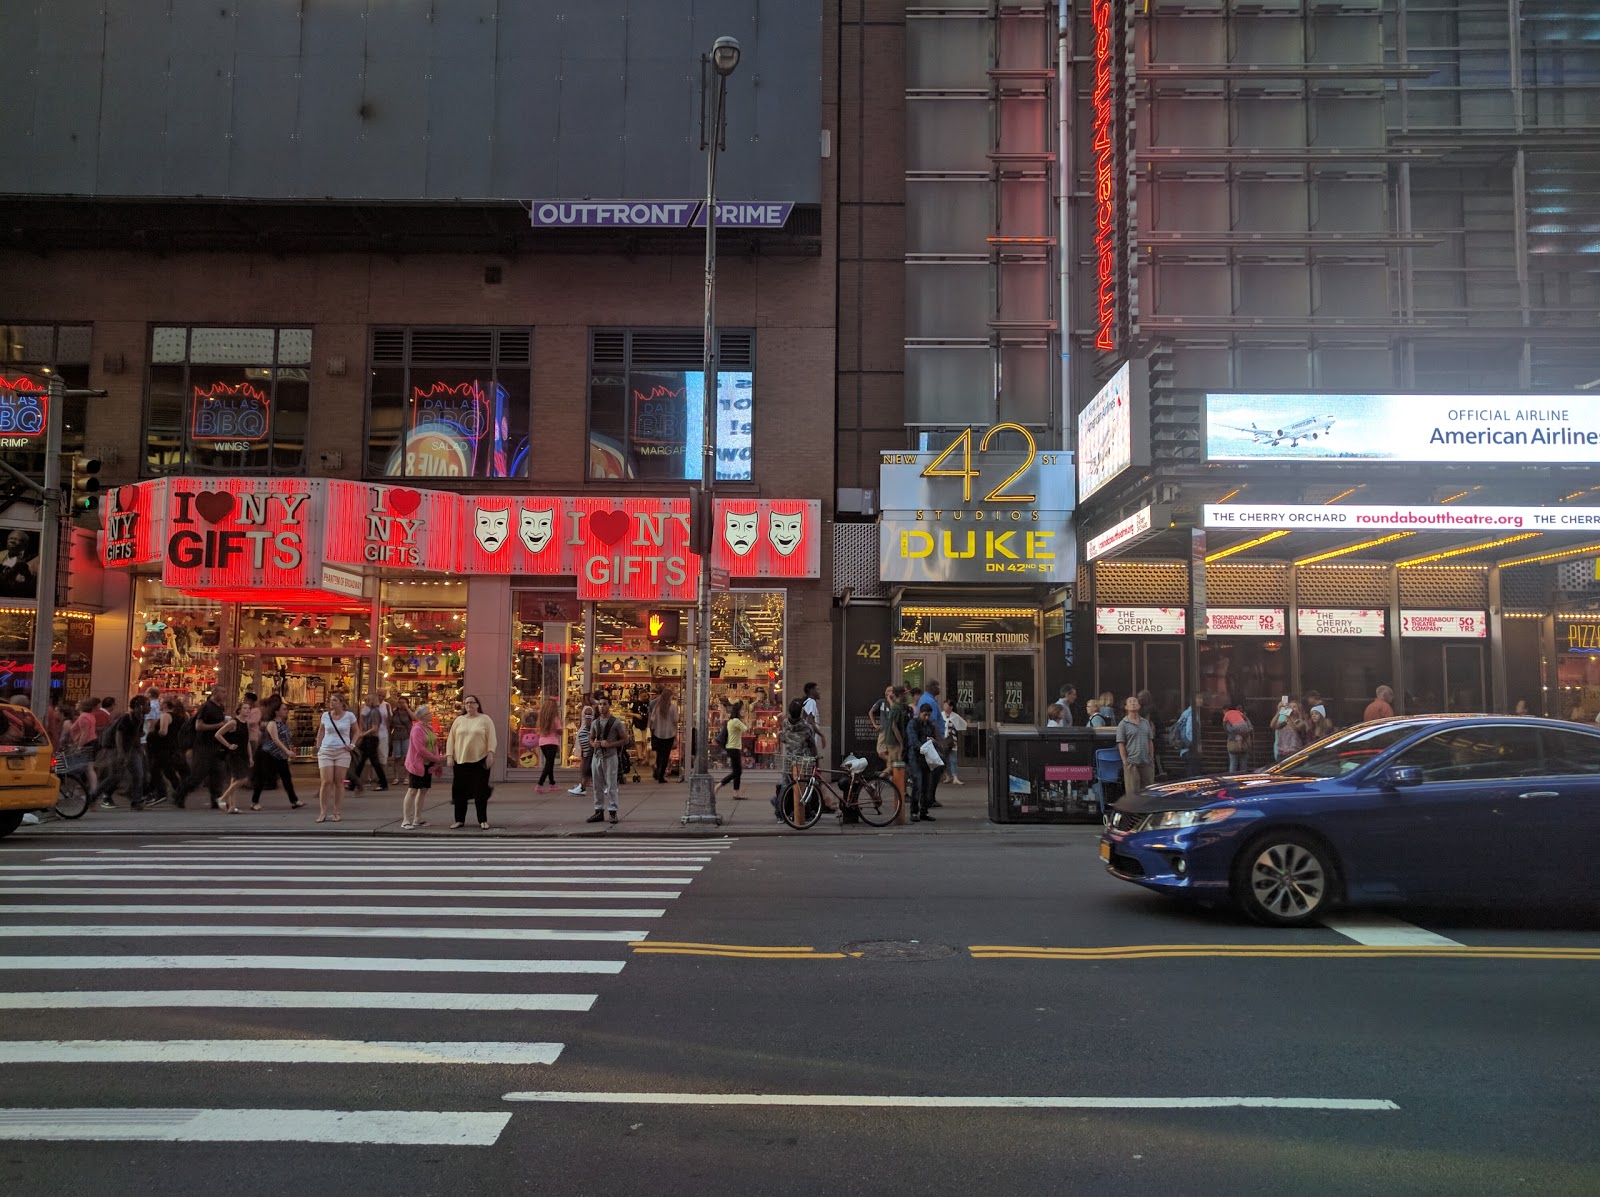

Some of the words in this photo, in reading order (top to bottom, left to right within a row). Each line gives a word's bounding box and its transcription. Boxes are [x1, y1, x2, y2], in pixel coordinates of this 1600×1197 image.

[538, 204, 688, 224] OUTFRONT
[1096, 147, 1114, 349] American
[203, 399, 259, 410] DALLAS
[423, 399, 479, 410] DALLAS
[196, 410, 264, 436] BBQ
[416, 410, 485, 437] BBQ
[1448, 409, 1511, 421] OFFICIAL
[1515, 409, 1569, 421] AIRLINE
[1429, 427, 1527, 445] American
[1531, 427, 1600, 445] Airline
[214, 442, 250, 451] WINGS
[431, 441, 469, 451] SALAD
[883, 455, 917, 465] NEW
[919, 422, 1037, 502] 42
[1042, 455, 1058, 465] ST
[111, 488, 119, 512] I
[173, 491, 195, 524] I
[234, 492, 311, 525] NY
[372, 486, 388, 512] I
[916, 510, 1040, 520] STUDIOS
[1212, 512, 1235, 522] THE
[1239, 512, 1286, 523] CHERRY
[1288, 513, 1347, 523] ORCHARD
[1356, 511, 1523, 527] roundabouttheatre.org
[1534, 515, 1557, 524] THE
[108, 512, 137, 541] NY
[365, 514, 425, 544] NY
[566, 511, 586, 545] I
[106, 541, 133, 560] GIFTS
[168, 530, 302, 569] GIFTS
[364, 543, 421, 564] GIFTS
[901, 530, 1056, 559] DUKE
[585, 555, 687, 585] GIFTS
[986, 563, 1005, 572] ON
[1007, 563, 1036, 572] 42ND
[1038, 564, 1056, 572] ST
[1117, 610, 1135, 618] THE
[1259, 615, 1274, 624] 50
[1459, 617, 1474, 625] 50
[900, 632, 916, 642] 229
[923, 632, 941, 642] NEW
[942, 632, 962, 643] 42ND
[965, 633, 994, 643] STREET
[995, 633, 1030, 643] STUDIOS
[856, 643, 881, 659] 42
[67, 679, 90, 688] BUY
[957, 688, 974, 704] 229
[1006, 689, 1022, 704] 229
